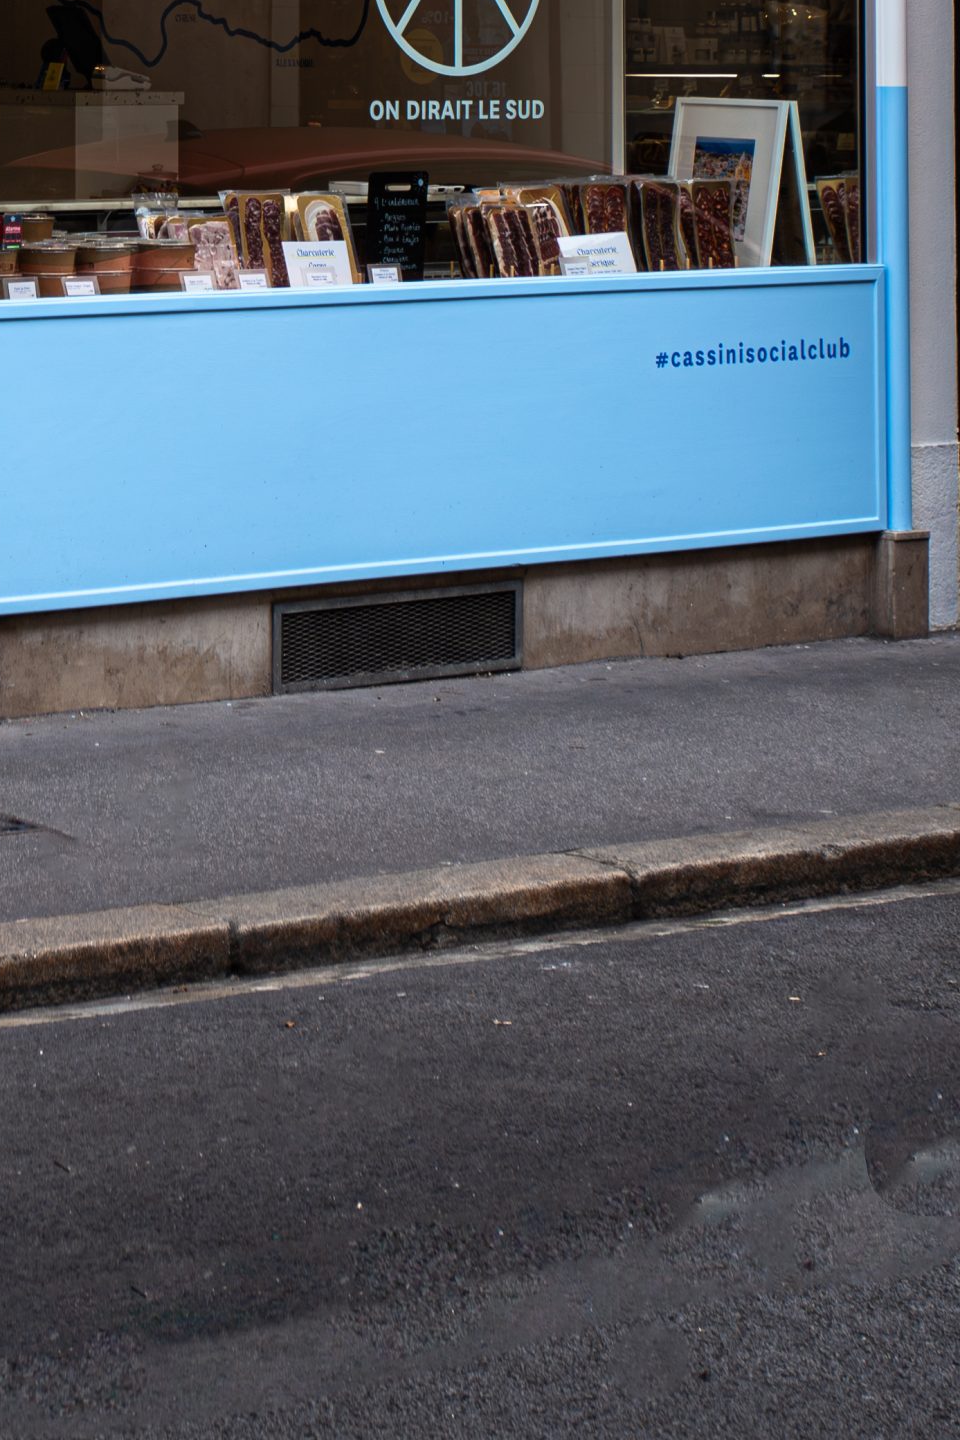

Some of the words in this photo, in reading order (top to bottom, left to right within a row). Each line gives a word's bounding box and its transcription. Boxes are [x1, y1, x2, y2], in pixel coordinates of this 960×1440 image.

[369, 100, 401, 121] ON
[406, 100, 473, 120] DIRAIT
[478, 100, 500, 120] LE
[505, 99, 546, 120] SUD
[655, 336, 852, 369] #cassinisocialclub
